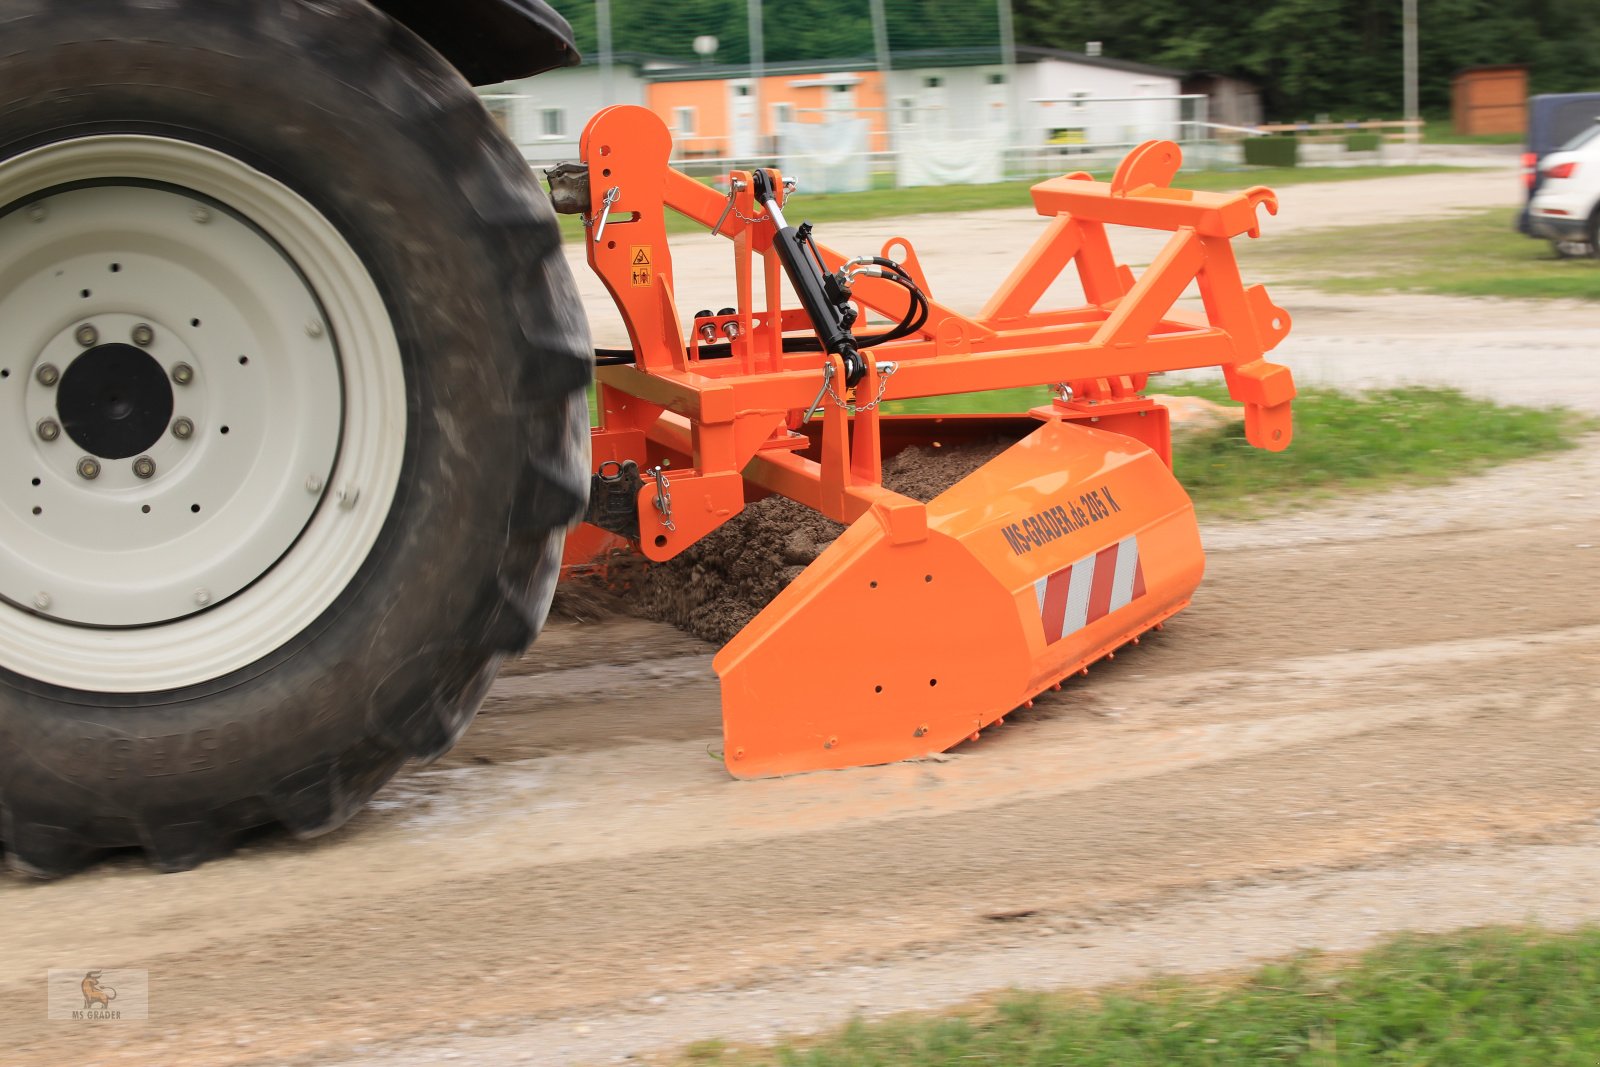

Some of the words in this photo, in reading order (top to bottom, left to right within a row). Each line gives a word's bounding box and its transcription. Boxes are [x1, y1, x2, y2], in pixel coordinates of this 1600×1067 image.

[1001, 501, 1090, 556] MS-GRADER.de
[1080, 490, 1110, 522] 205
[1101, 485, 1121, 513] K
